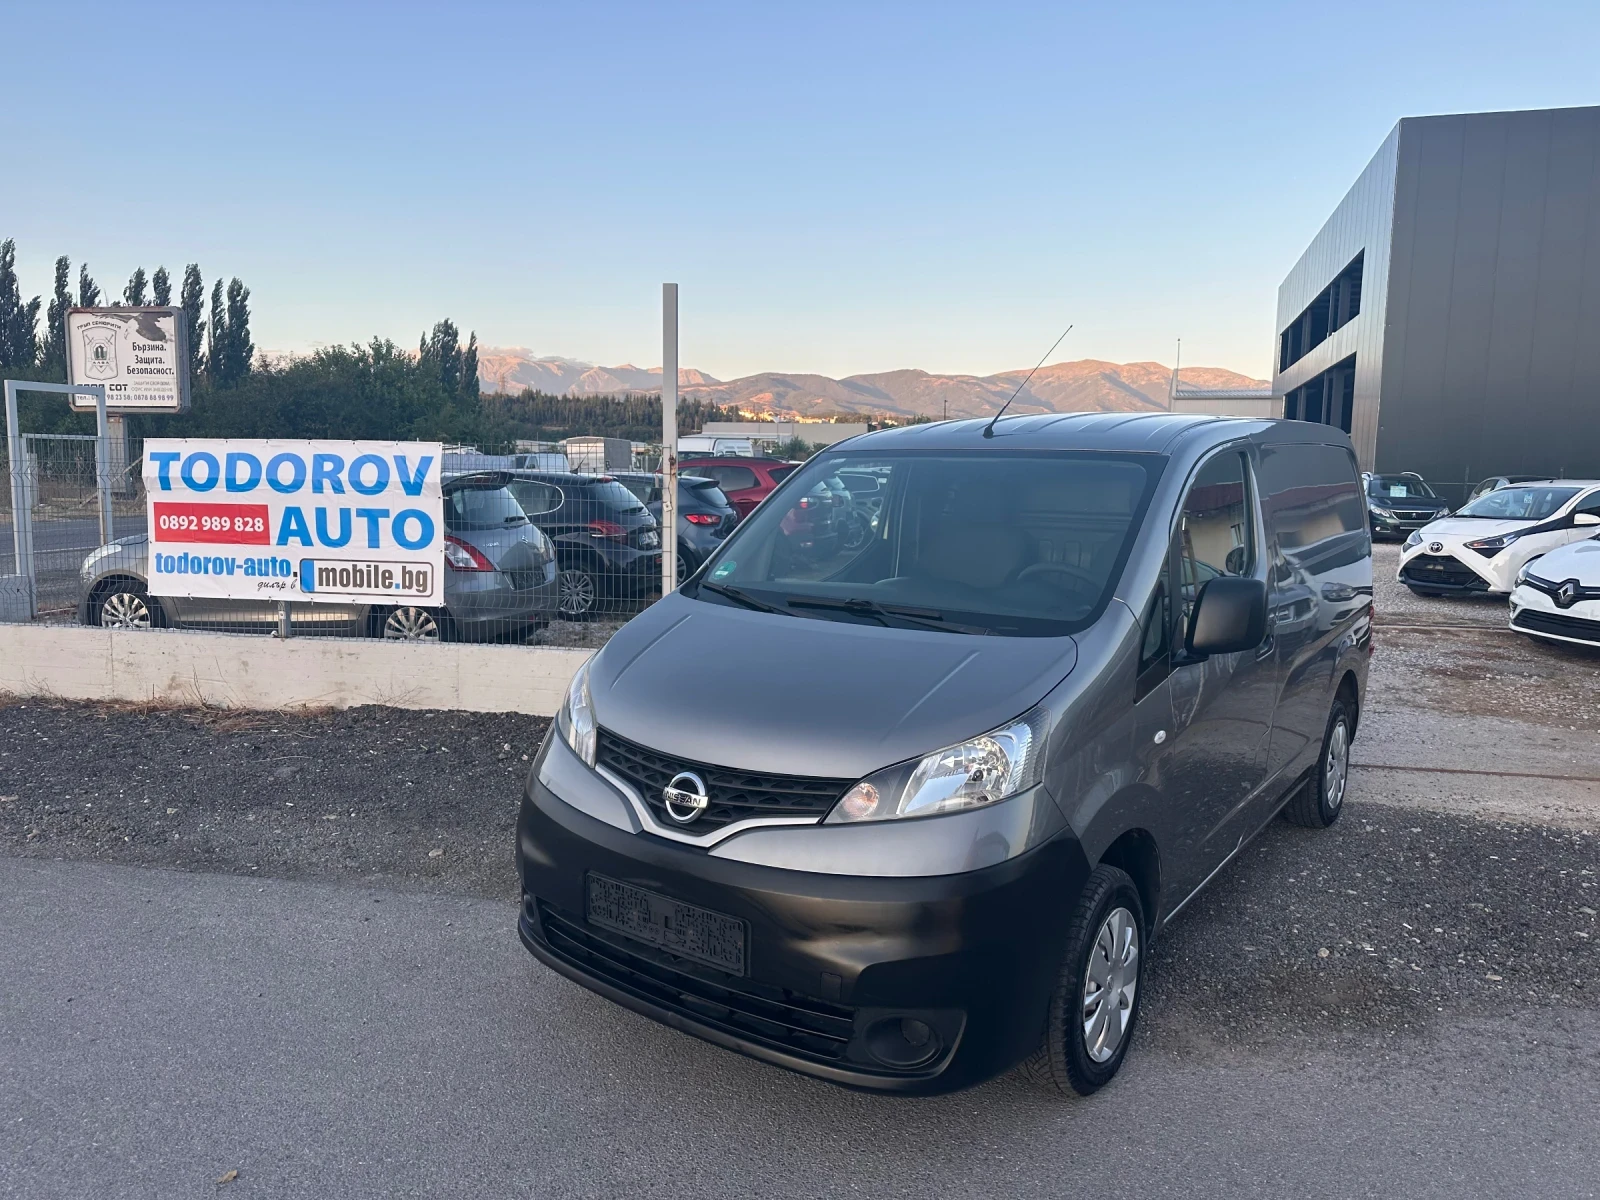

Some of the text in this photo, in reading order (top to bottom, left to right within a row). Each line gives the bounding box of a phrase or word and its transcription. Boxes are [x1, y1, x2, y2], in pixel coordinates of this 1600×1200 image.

[132, 342, 167, 354] Бързина.
[134, 355, 165, 366] Защита.
[126, 365, 175, 375] Безопасност.
[109, 383, 128, 391] СОТ
[149, 451, 434, 497] TODOROV
[159, 514, 264, 532] 0892 989 828
[275, 506, 435, 551] AUTO
[318, 563, 428, 593] mobile.bg
[665, 790, 702, 806] NISSAN
